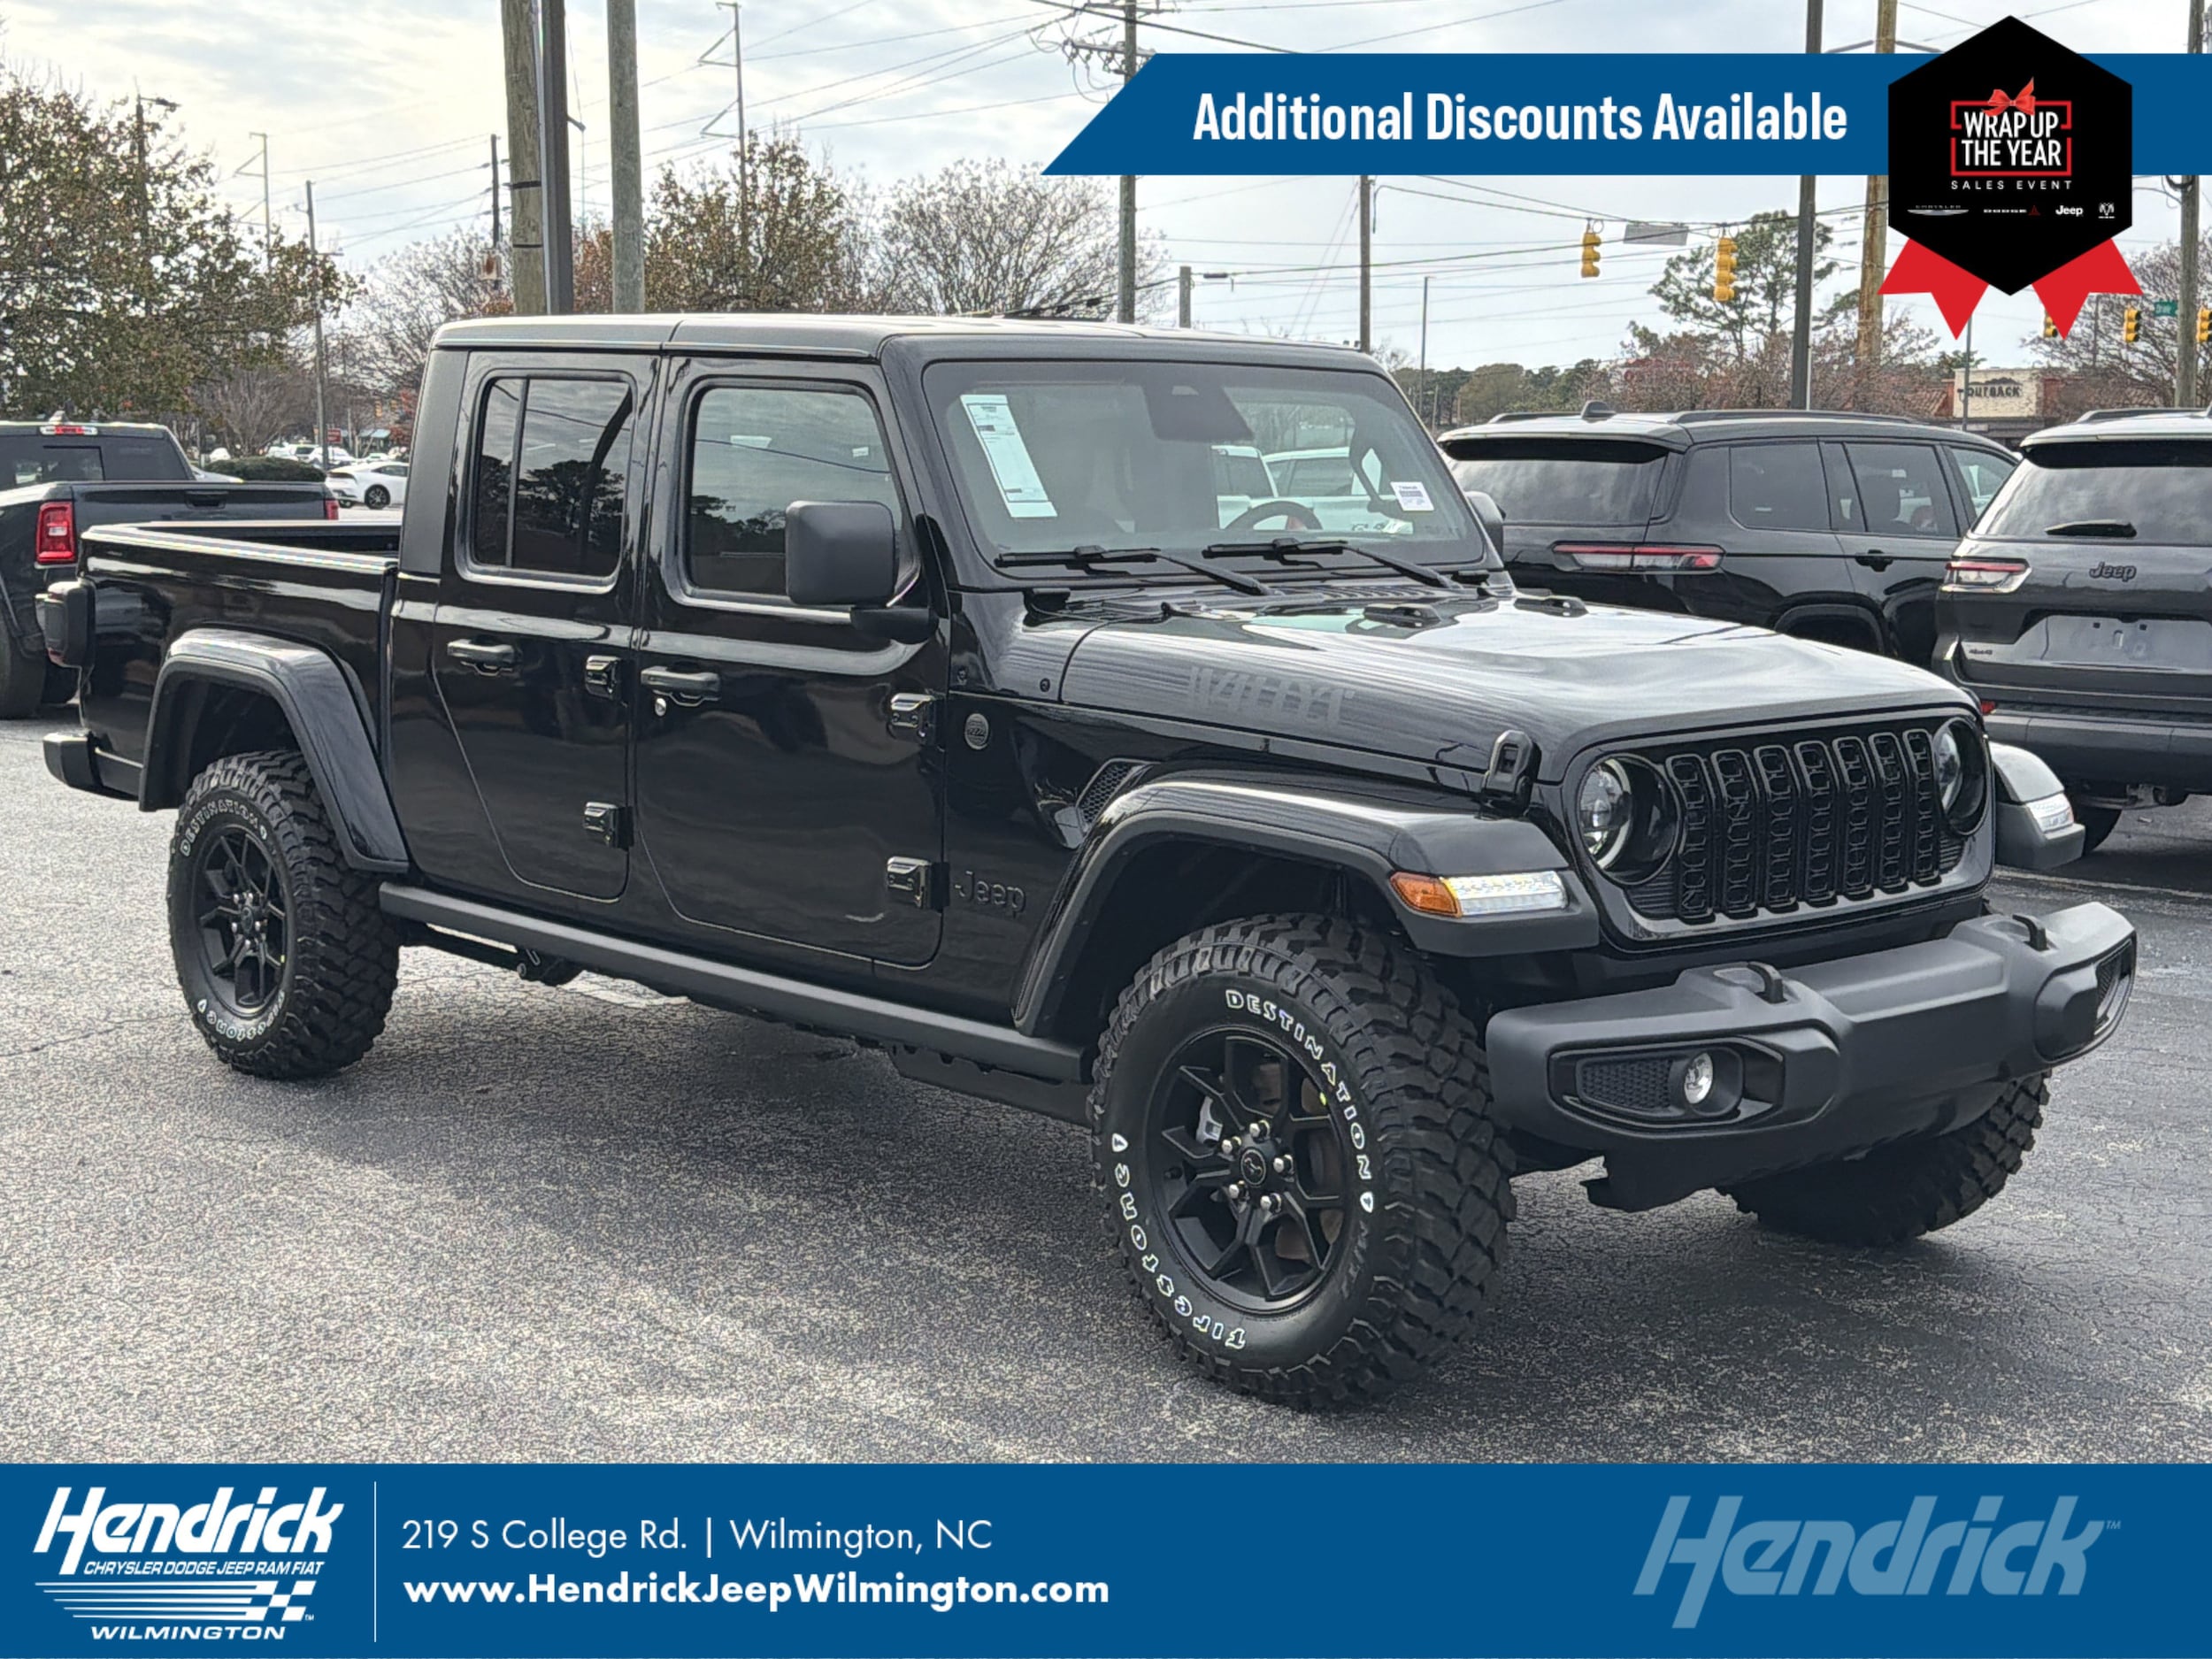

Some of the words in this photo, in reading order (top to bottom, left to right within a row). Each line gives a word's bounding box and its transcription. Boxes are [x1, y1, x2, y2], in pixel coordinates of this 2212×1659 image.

[1968, 386, 2021, 397] OUTBACK
[2089, 561, 2137, 582] Jeep
[180, 798, 258, 856] DESTINATION
[954, 870, 1026, 919] Jeep
[1225, 988, 1372, 1180] DESTINATION
